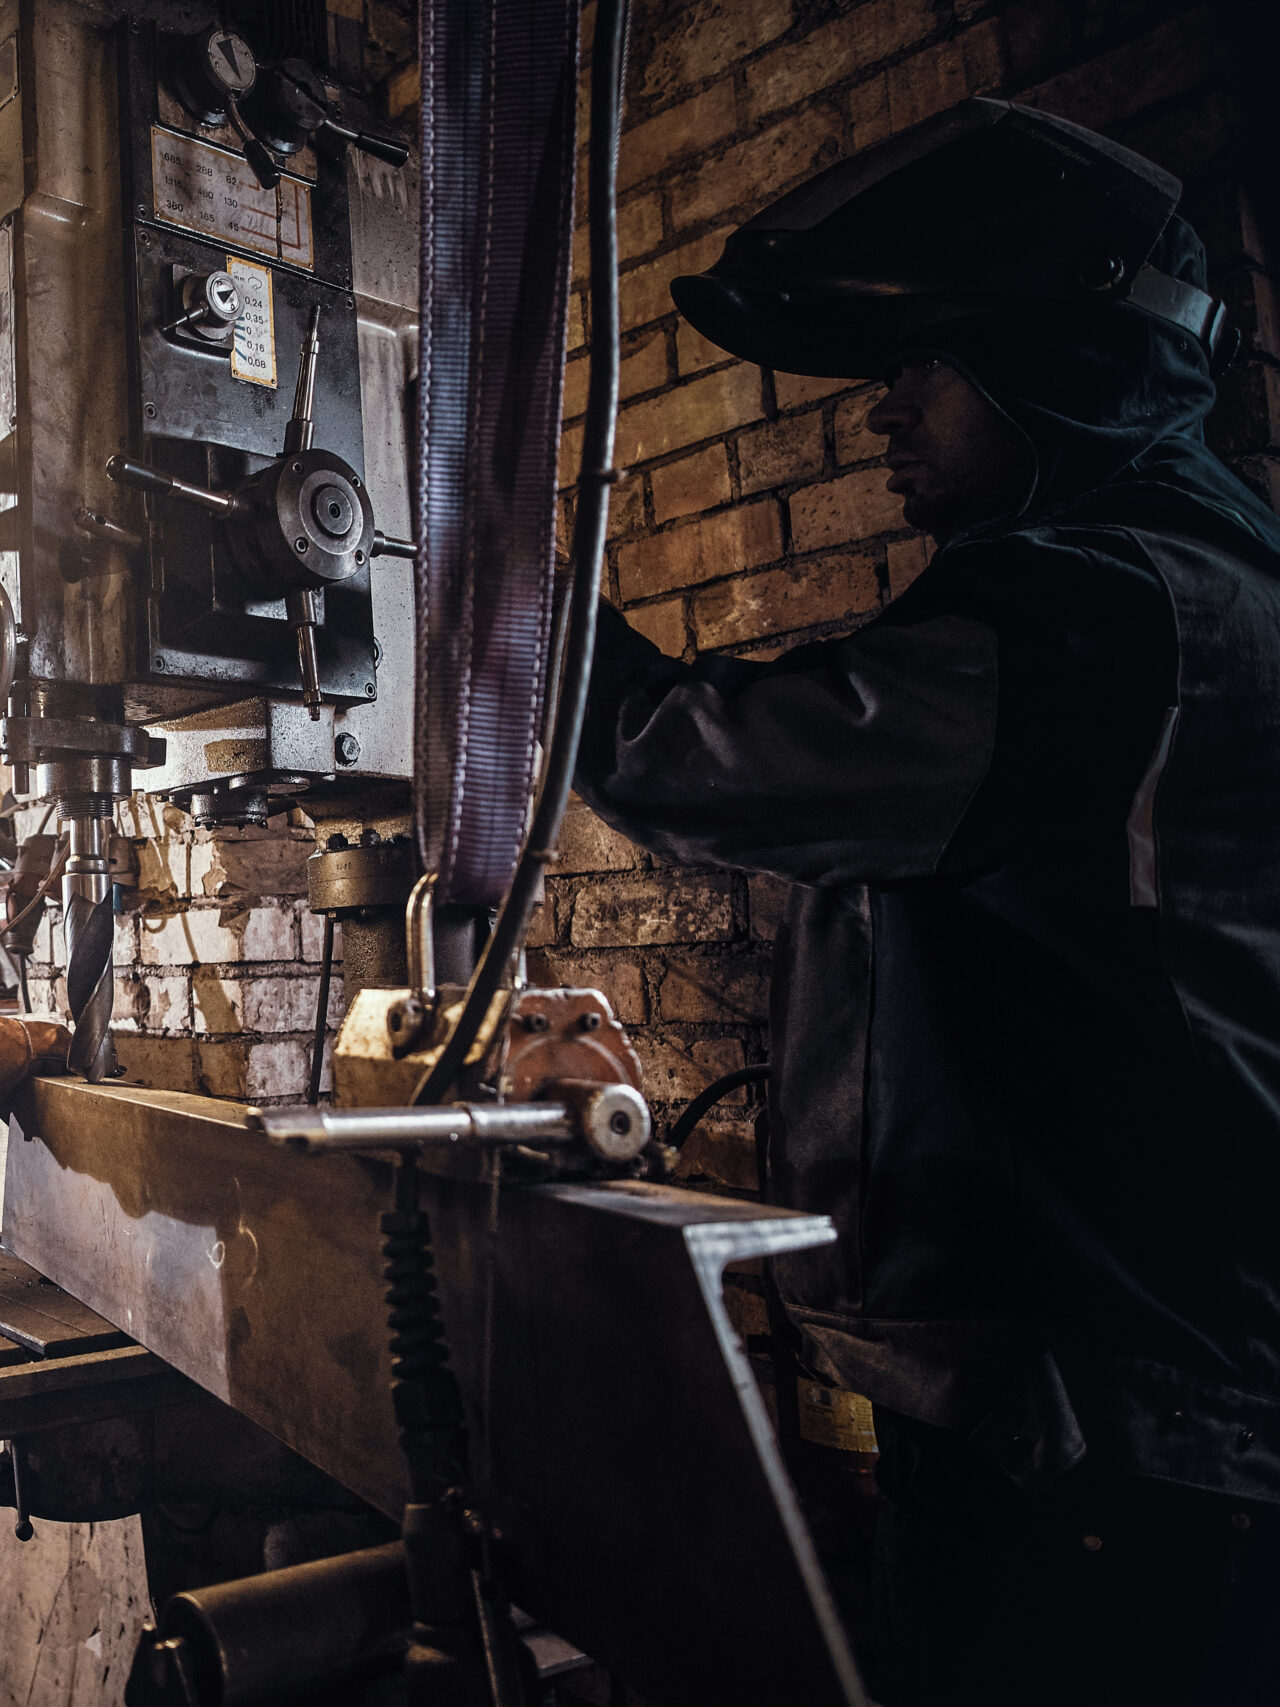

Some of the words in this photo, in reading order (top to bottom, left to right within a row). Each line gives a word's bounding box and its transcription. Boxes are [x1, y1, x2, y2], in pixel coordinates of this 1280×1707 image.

[226, 175, 237, 186] 82
[223, 197, 238, 208] 130
[166, 200, 184, 212] 380
[228, 221, 239, 232] 45
